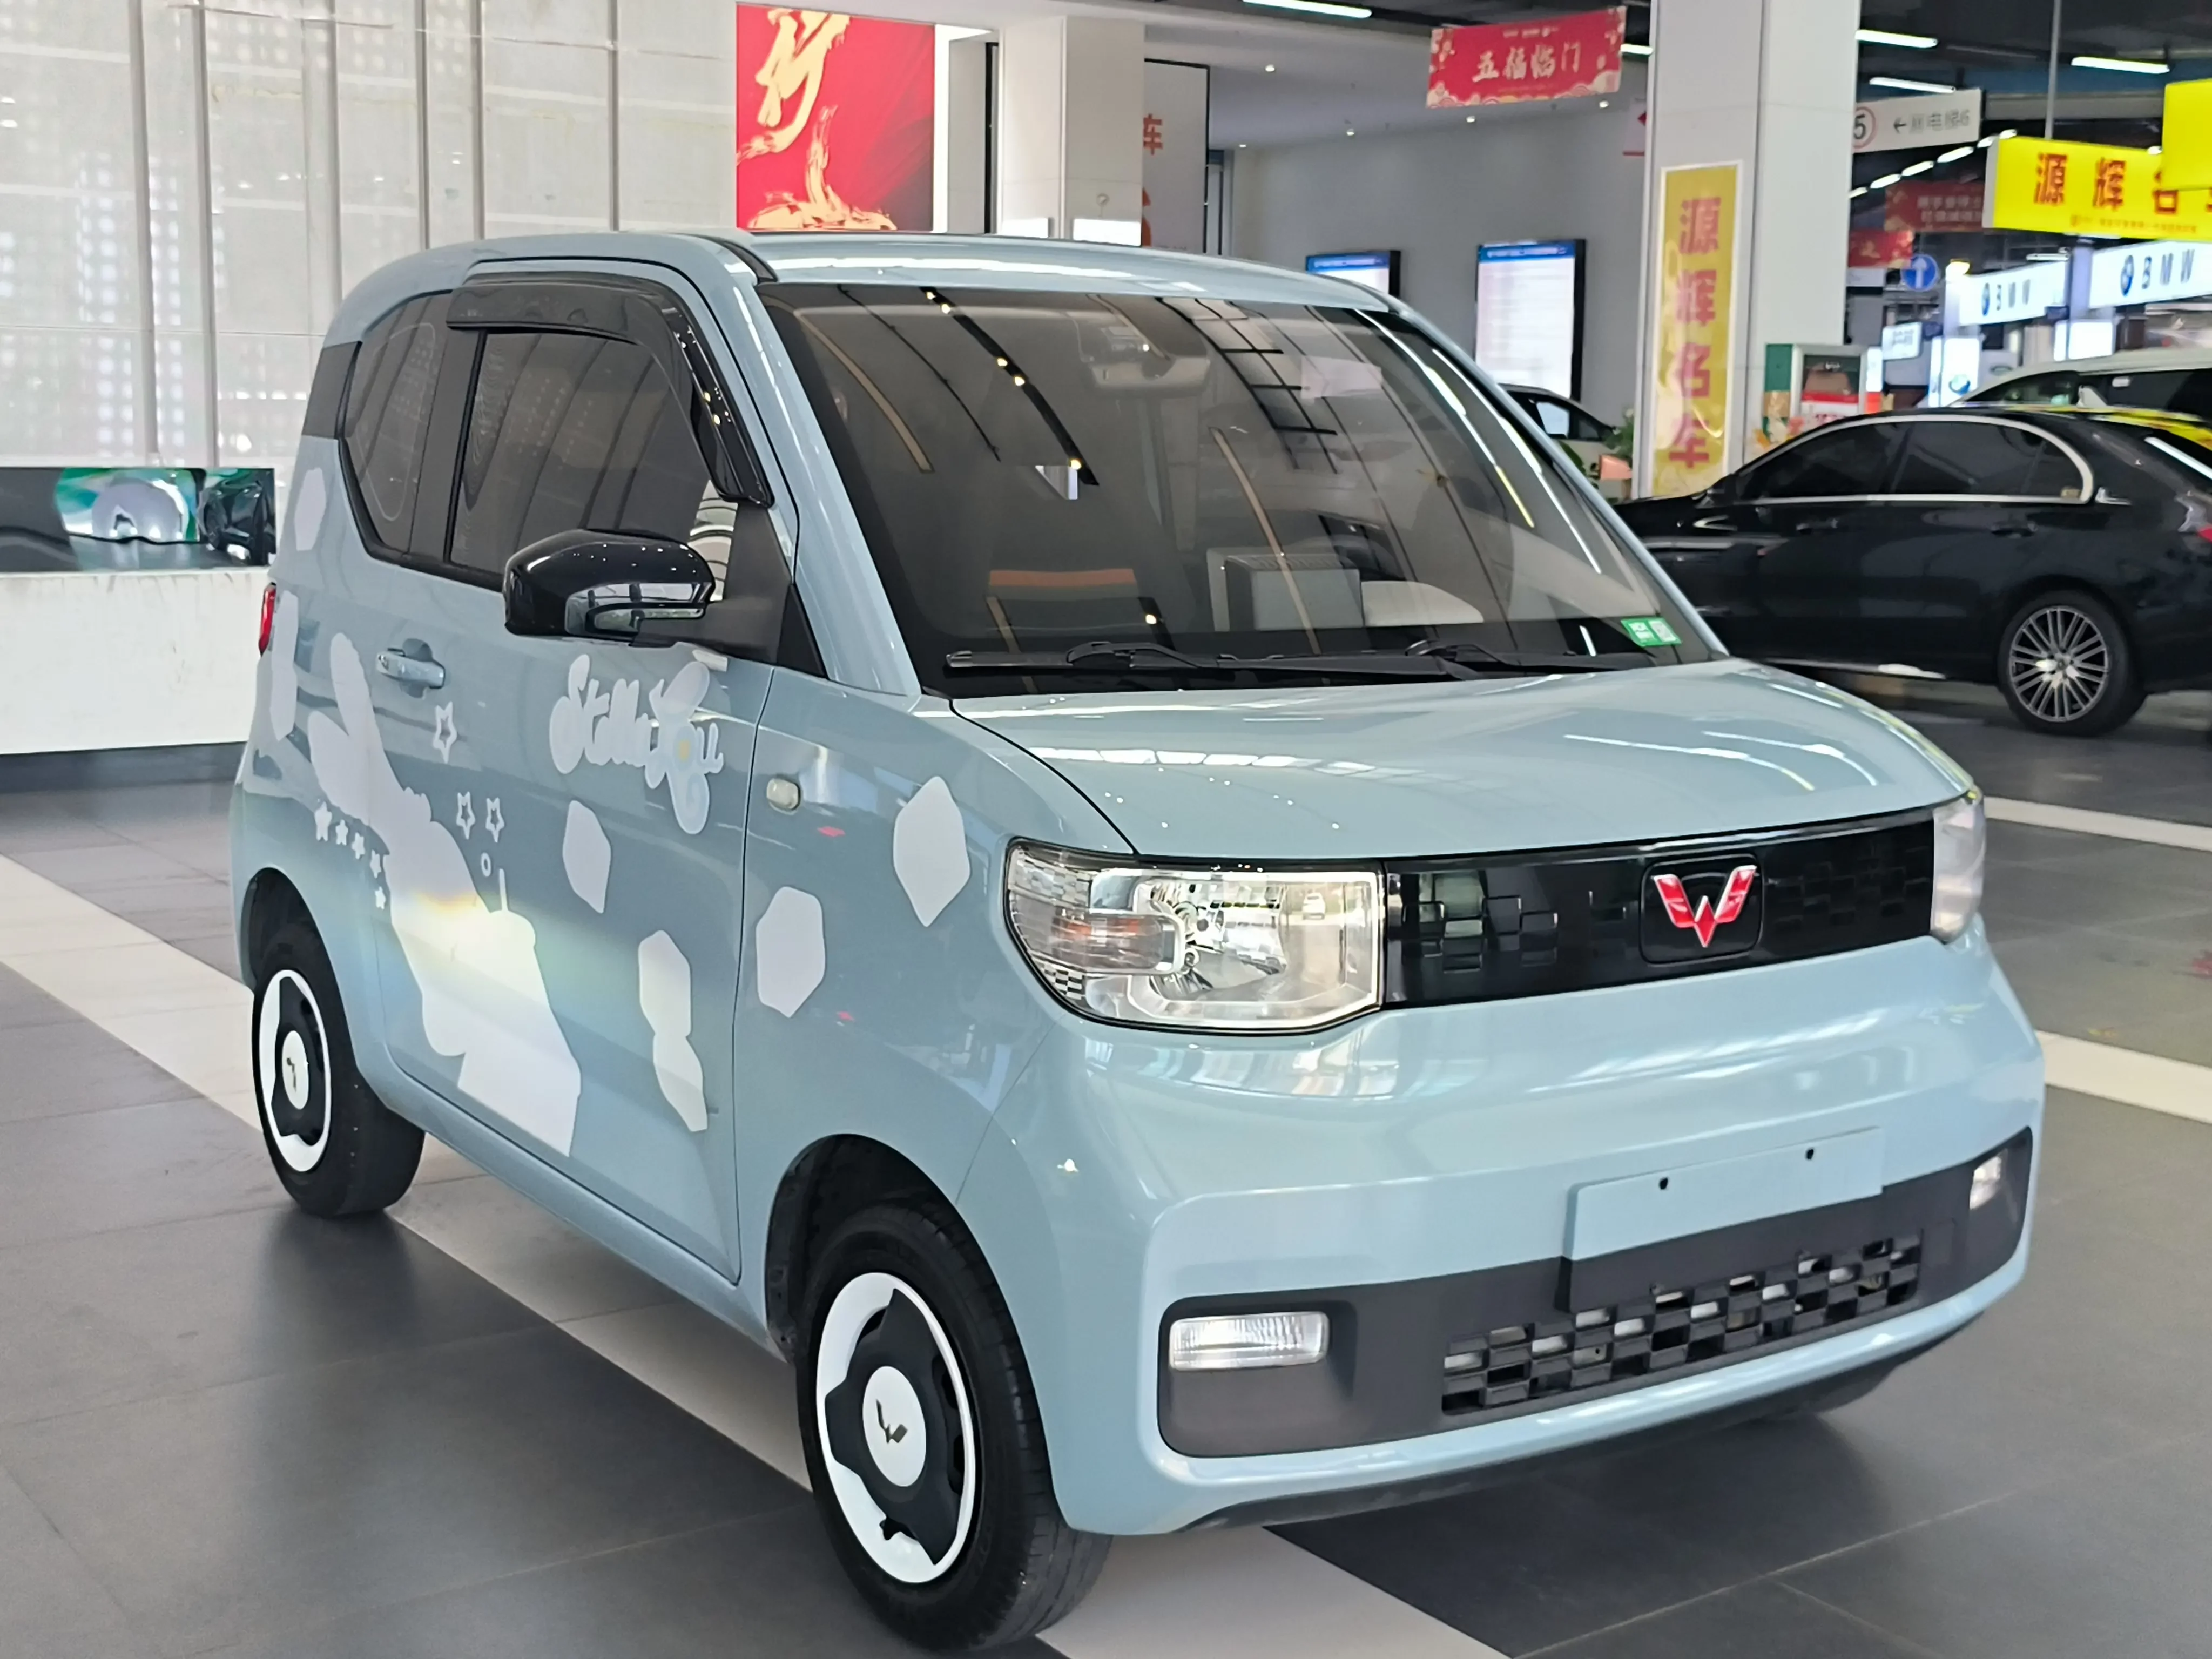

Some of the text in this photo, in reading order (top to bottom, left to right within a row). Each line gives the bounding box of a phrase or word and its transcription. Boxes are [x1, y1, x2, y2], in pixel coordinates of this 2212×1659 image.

[1472, 41, 1580, 83] 五福临门
[2142, 249, 2195, 289] BMW
[1669, 197, 1721, 469] 源辉名车
